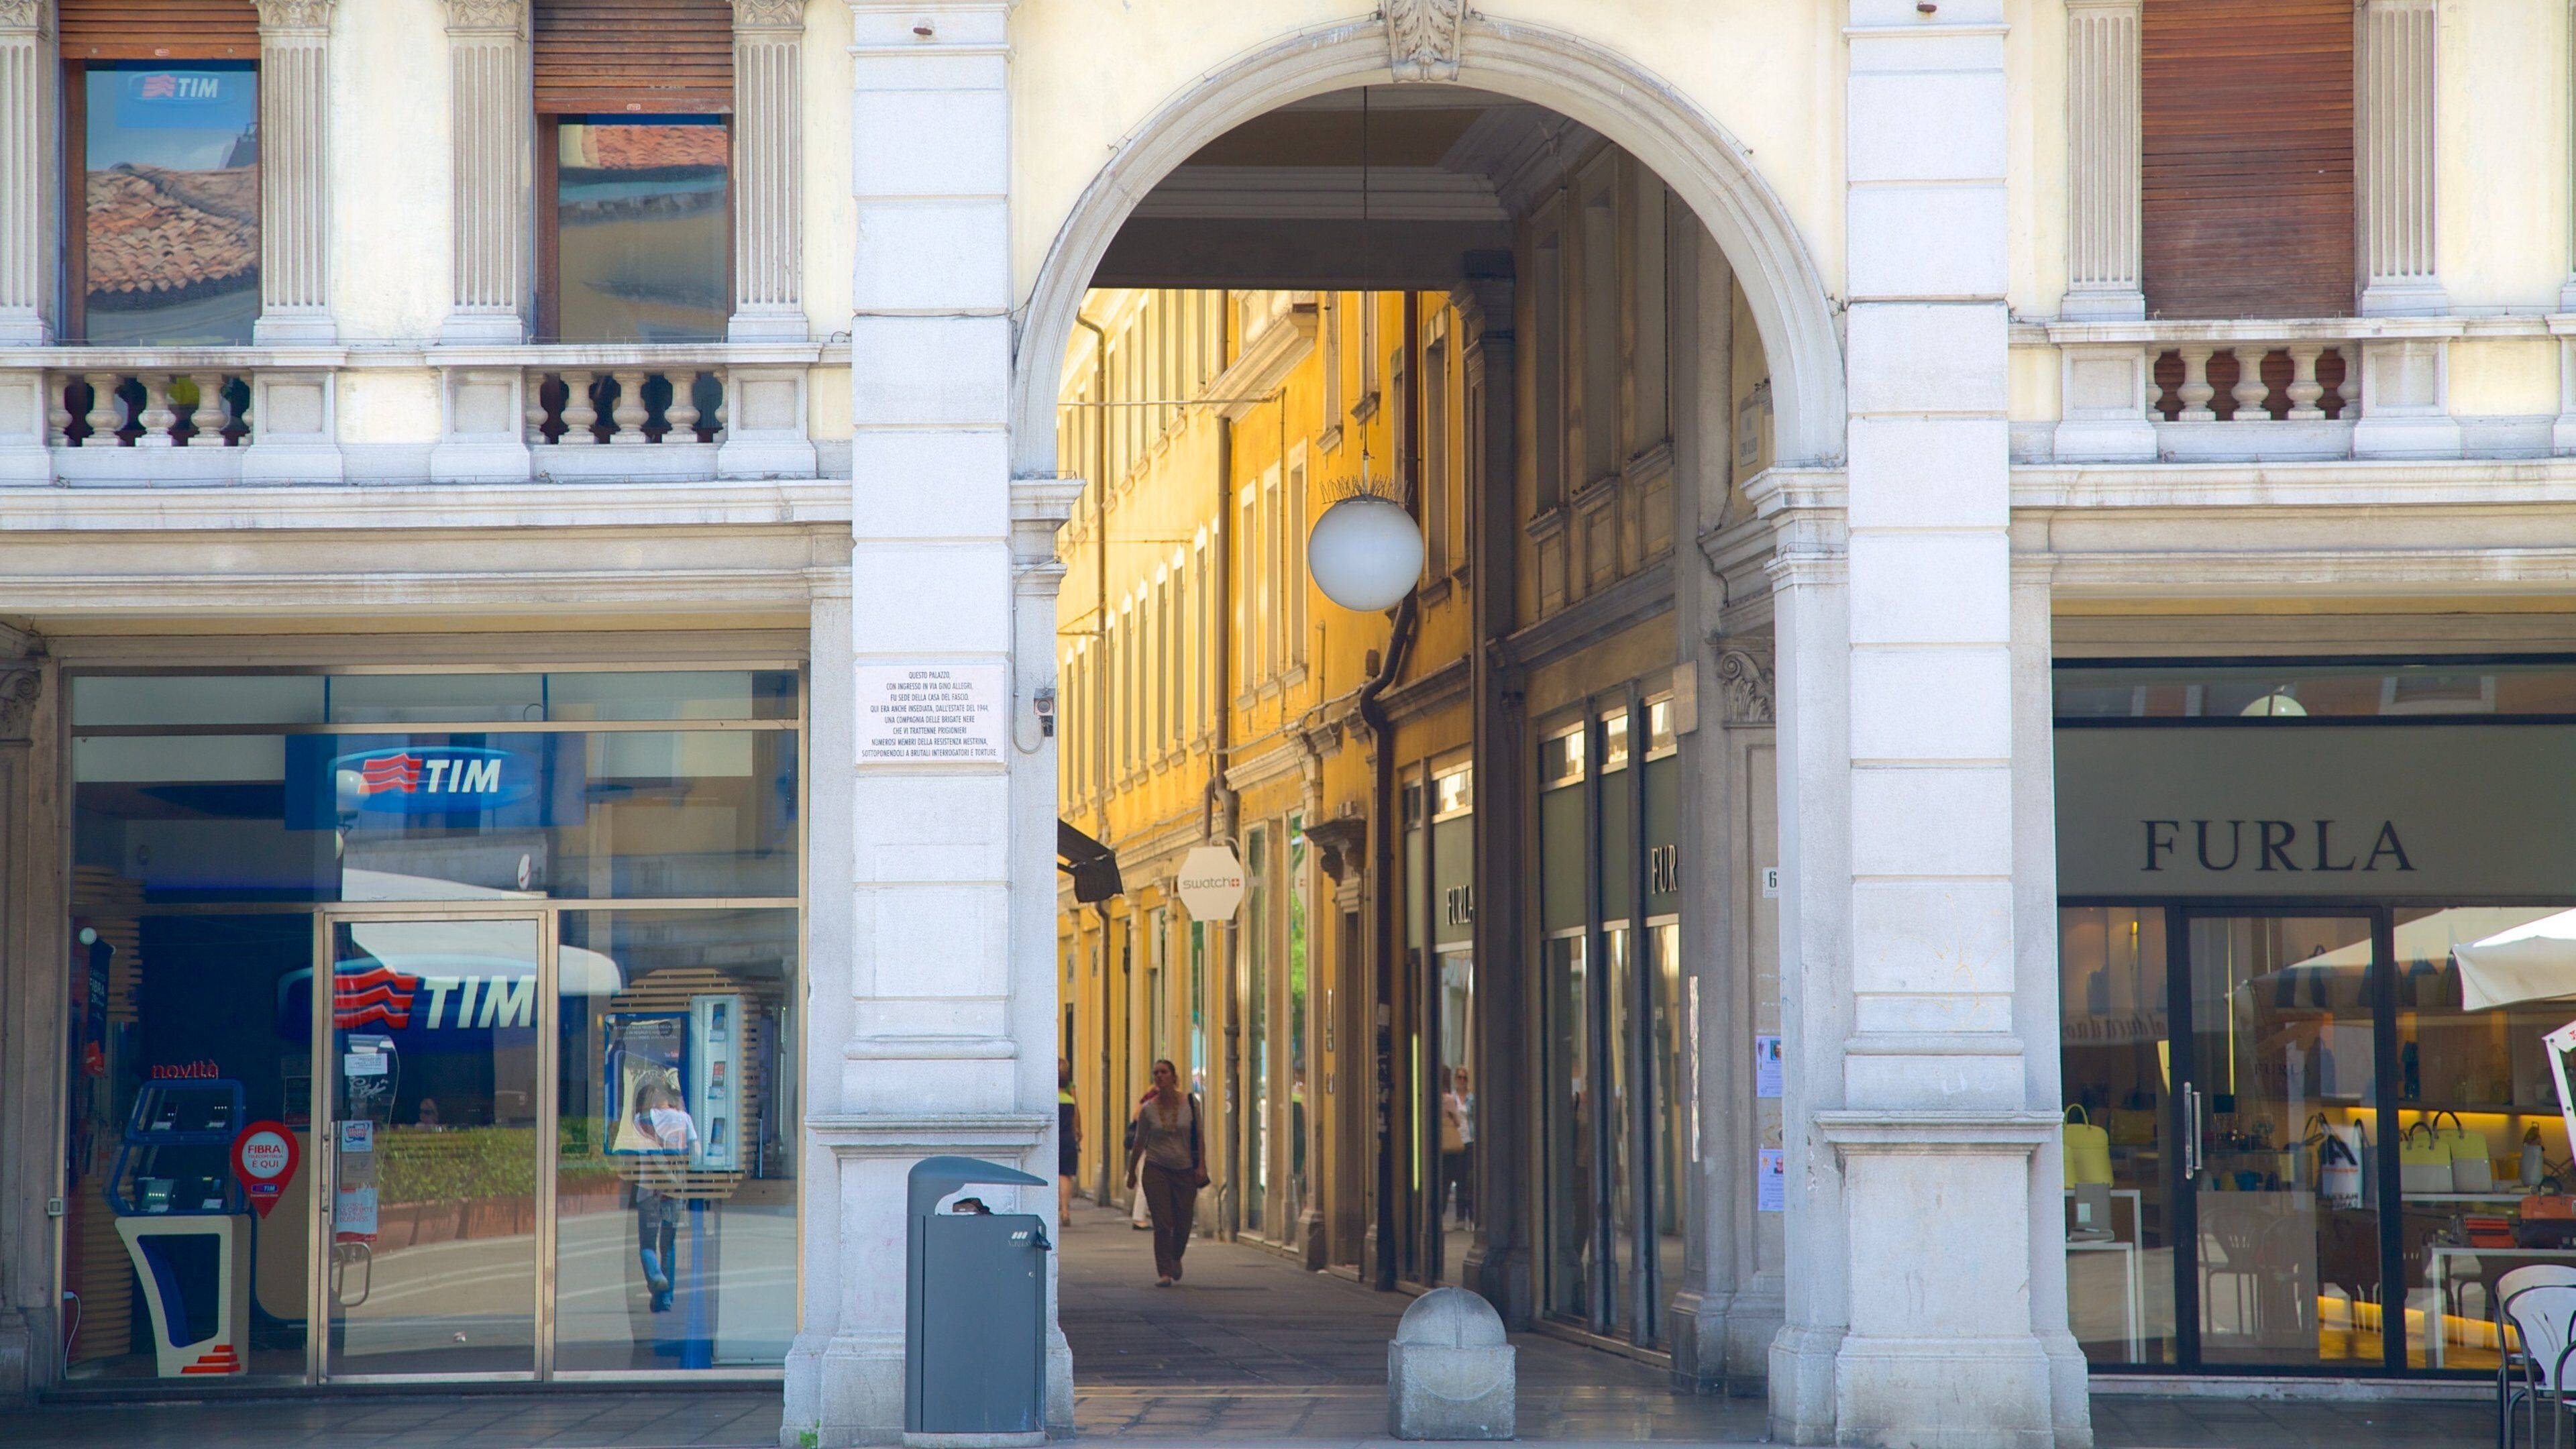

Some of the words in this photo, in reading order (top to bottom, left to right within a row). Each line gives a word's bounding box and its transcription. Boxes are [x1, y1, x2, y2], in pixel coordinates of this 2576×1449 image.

[178, 78, 218, 98] TIM
[908, 671, 927, 680] QUESTO
[886, 683, 896, 691] CON
[898, 683, 921, 691] INGRESSO
[923, 683, 928, 691] IN
[929, 683, 937, 691] VIA
[939, 683, 951, 691] GINO
[891, 694, 897, 702] FU
[898, 694, 910, 702] SEDE
[912, 694, 926, 702] DELLA
[928, 694, 939, 702] CASA
[941, 694, 950, 702] DEL
[870, 705, 879, 713] QUI
[881, 705, 890, 713] ERA
[891, 705, 907, 713] ANCHE
[935, 705, 965, 713] DALL'ESTATE
[966, 705, 975, 713] DEL
[884, 716, 895, 724] UNA
[896, 716, 924, 724] COMPAGNIA
[926, 716, 941, 724] DELLE
[942, 716, 961, 724] BRIGATE
[963, 716, 975, 724] NERE
[872, 738, 896, 746] NUMEROSI
[898, 738, 916, 746] MEMBRI
[918, 738, 932, 746] DELLA
[934, 738, 962, 746] RESISTENZA
[862, 749, 904, 757] SOTTOPONENDOLI
[906, 749, 909, 757] A
[911, 749, 930, 757] BRUTALI
[932, 749, 969, 757] INTERROGATORI
[971, 749, 973, 757] E
[426, 759, 501, 793] TIM
[2140, 820, 2418, 871] FURLA
[1183, 877, 1230, 890] swatch
[1769, 871, 1777, 888] 6
[423, 975, 536, 1029] TIM
[152, 1059, 218, 1079] novità
[248, 1144, 281, 1154] FIBRA
[260, 1160, 279, 1169] QUI
